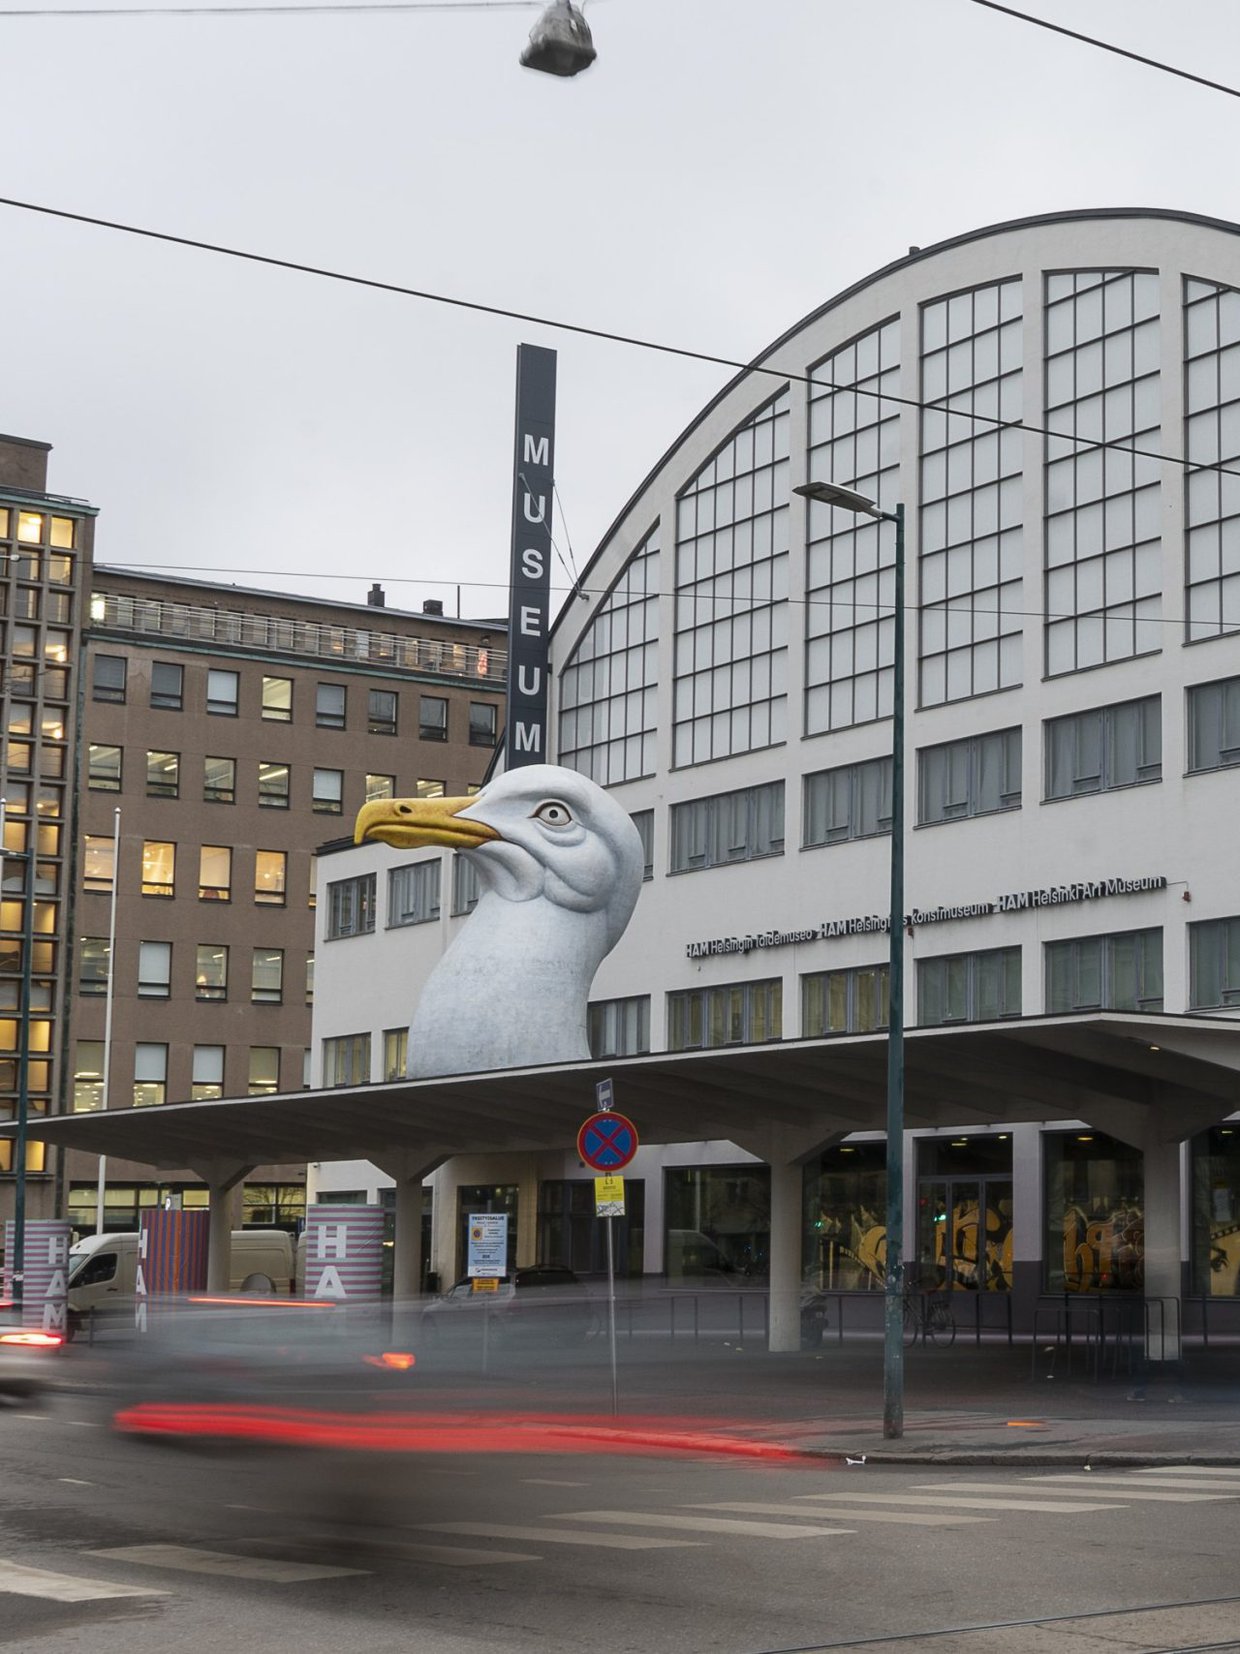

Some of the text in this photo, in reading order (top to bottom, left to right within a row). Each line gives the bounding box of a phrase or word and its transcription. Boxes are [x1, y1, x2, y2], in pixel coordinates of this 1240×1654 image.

[514, 433, 549, 753] MUSEUM
[686, 943, 709, 957] HAM
[711, 936, 752, 954] Helsingin
[820, 920, 847, 938] HAM
[850, 914, 907, 933] Helsings
[999, 892, 1029, 911] HAM
[1032, 883, 1081, 907] Helsinki
[1082, 882, 1102, 900] Art
[1105, 876, 1163, 897] Museum
[42, 1236, 68, 1331] HAM
[314, 1225, 348, 1302] HA
